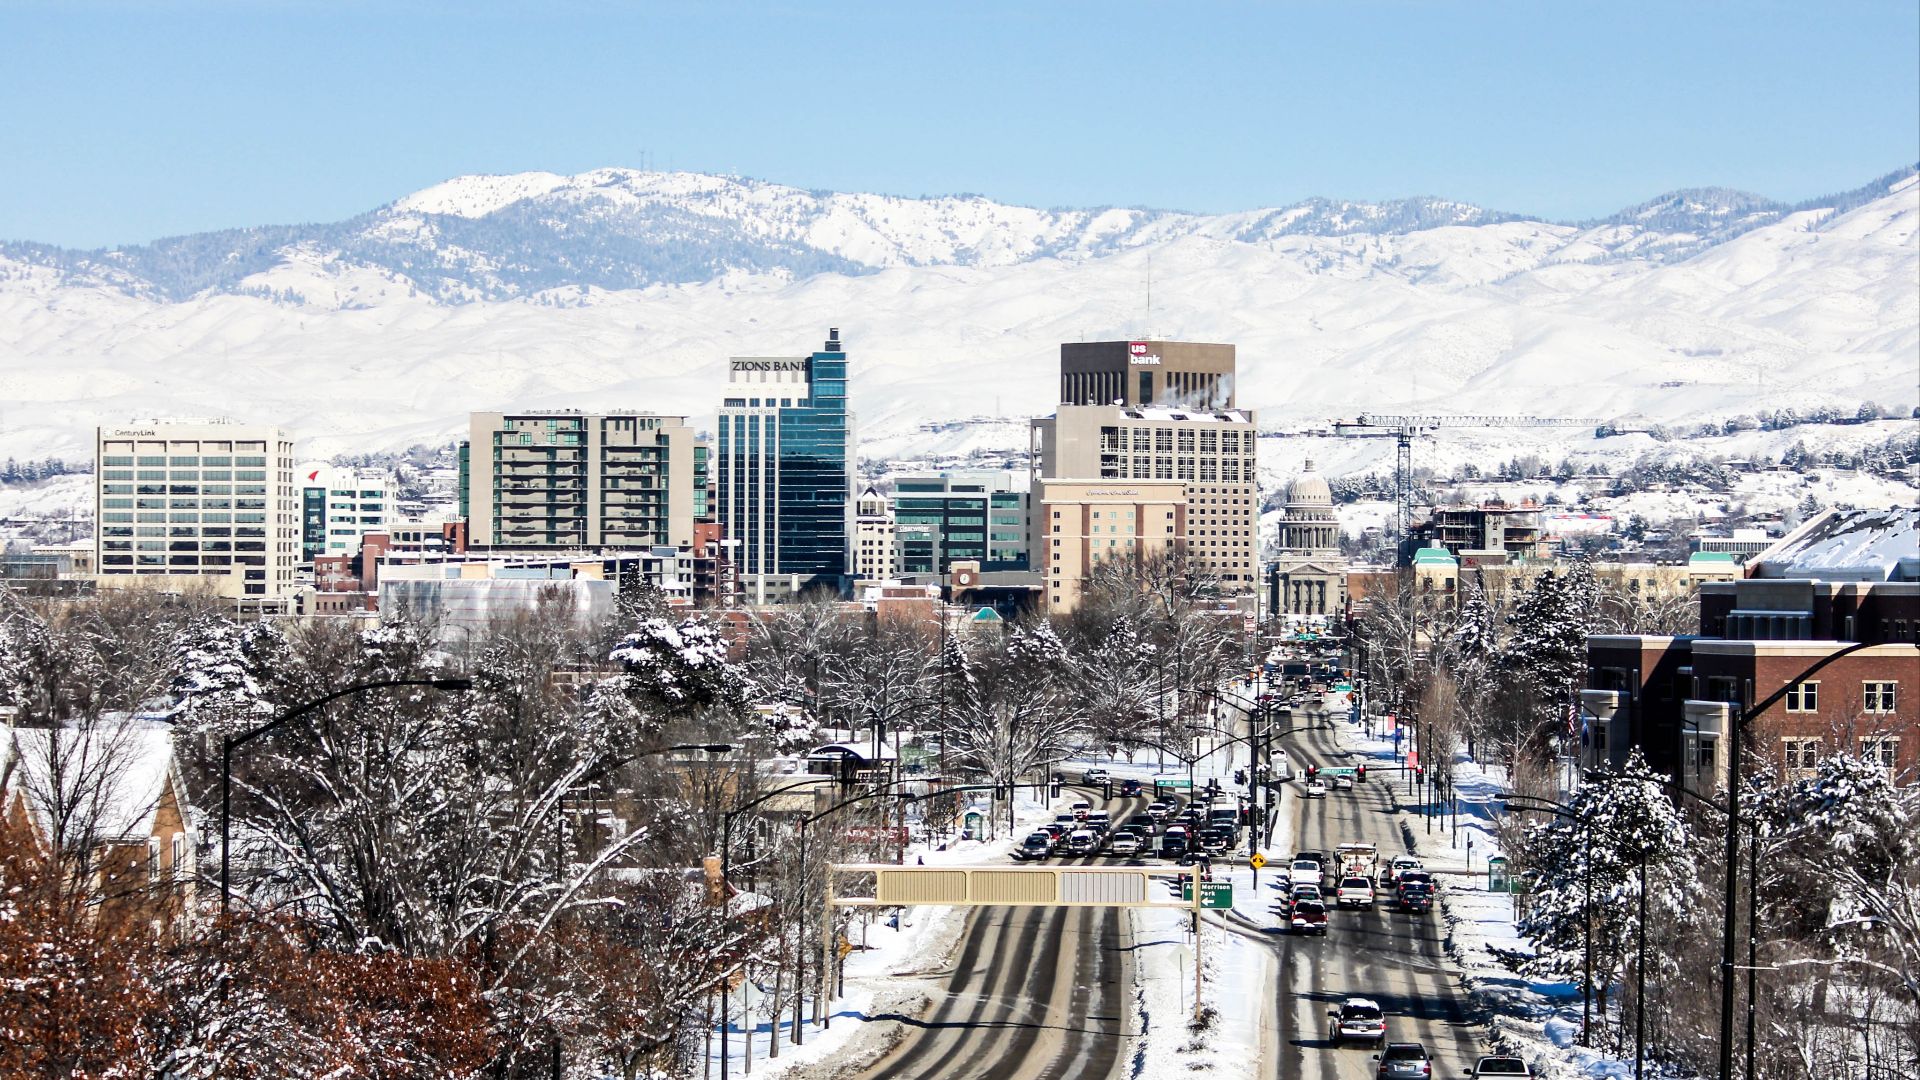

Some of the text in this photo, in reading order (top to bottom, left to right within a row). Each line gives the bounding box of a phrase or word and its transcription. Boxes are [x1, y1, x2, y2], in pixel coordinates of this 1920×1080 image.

[1131, 344, 1147, 354] us
[1130, 354, 1161, 365] bank
[732, 361, 771, 371] ZIONS
[115, 429, 155, 437] CenturyLink
